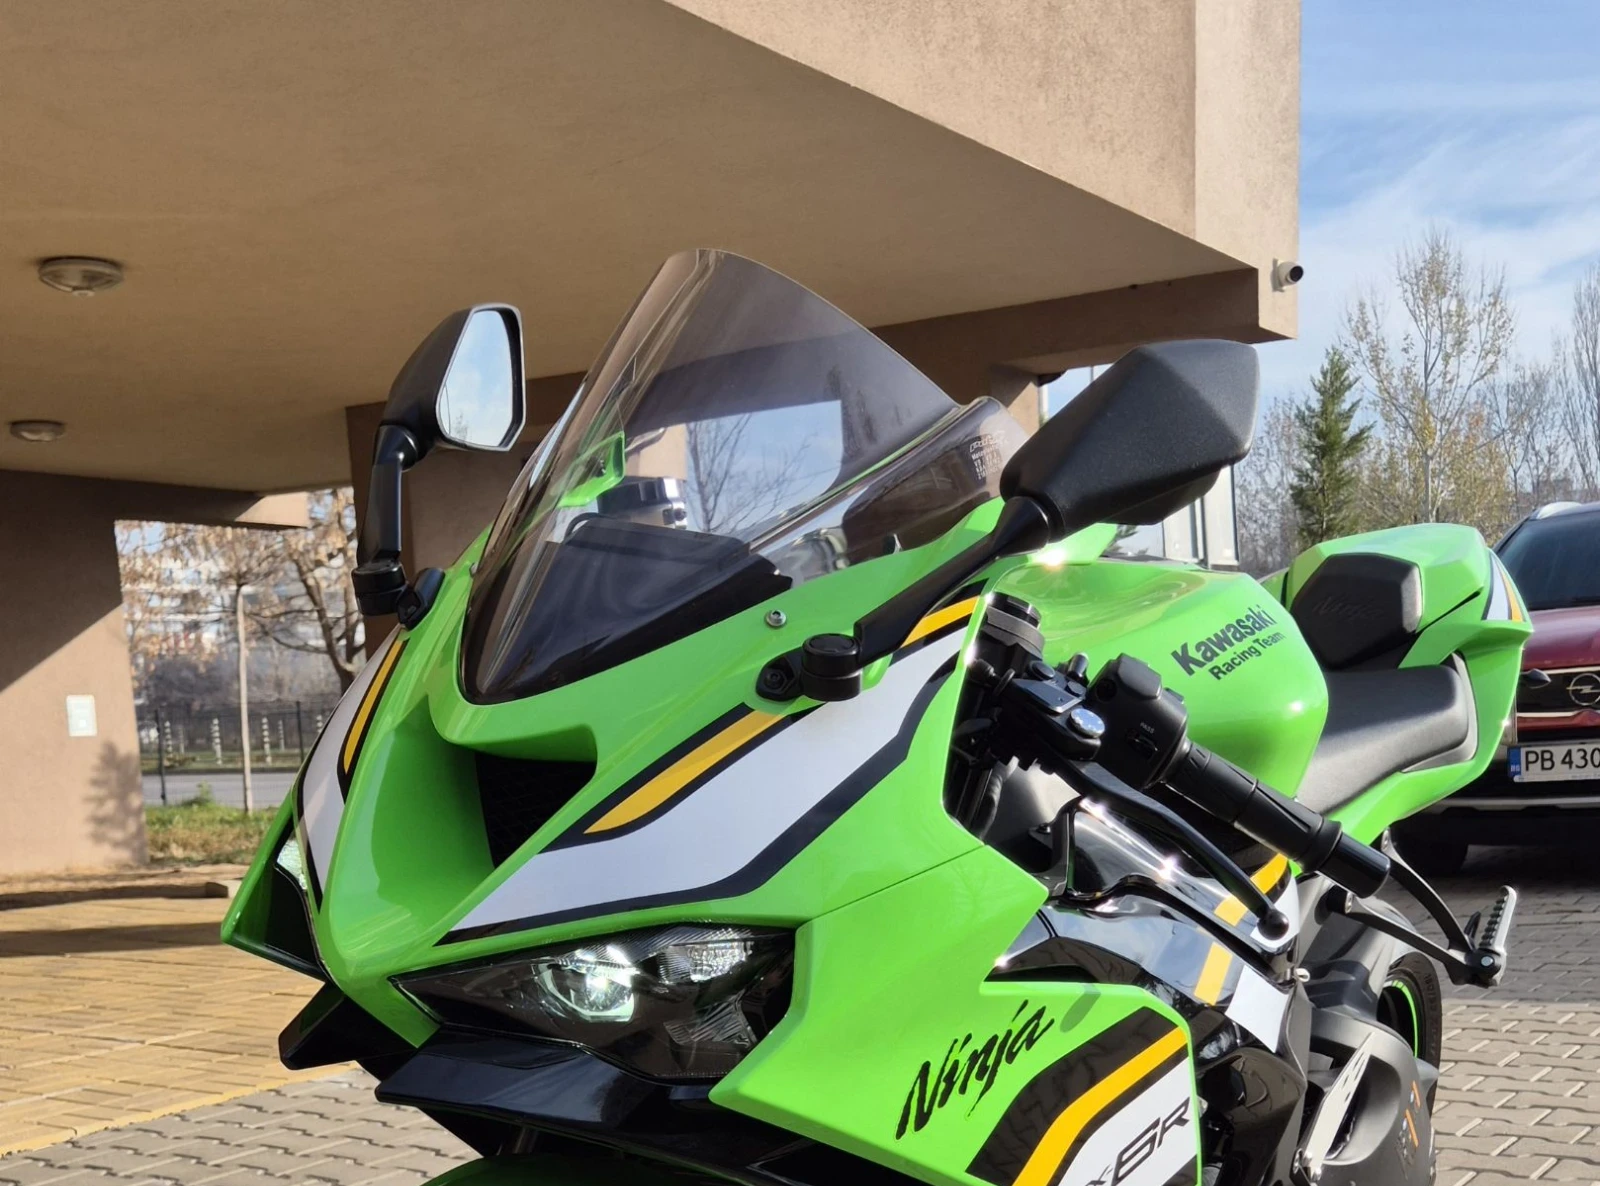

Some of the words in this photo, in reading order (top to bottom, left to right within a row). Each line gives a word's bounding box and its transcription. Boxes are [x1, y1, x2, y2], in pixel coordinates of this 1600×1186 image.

[1170, 604, 1278, 676] Kawasaki
[1208, 645, 1262, 680] Racing
[1252, 631, 1287, 649] Team
[1525, 749, 1556, 772] PB
[895, 999, 1055, 1141] Ninja
